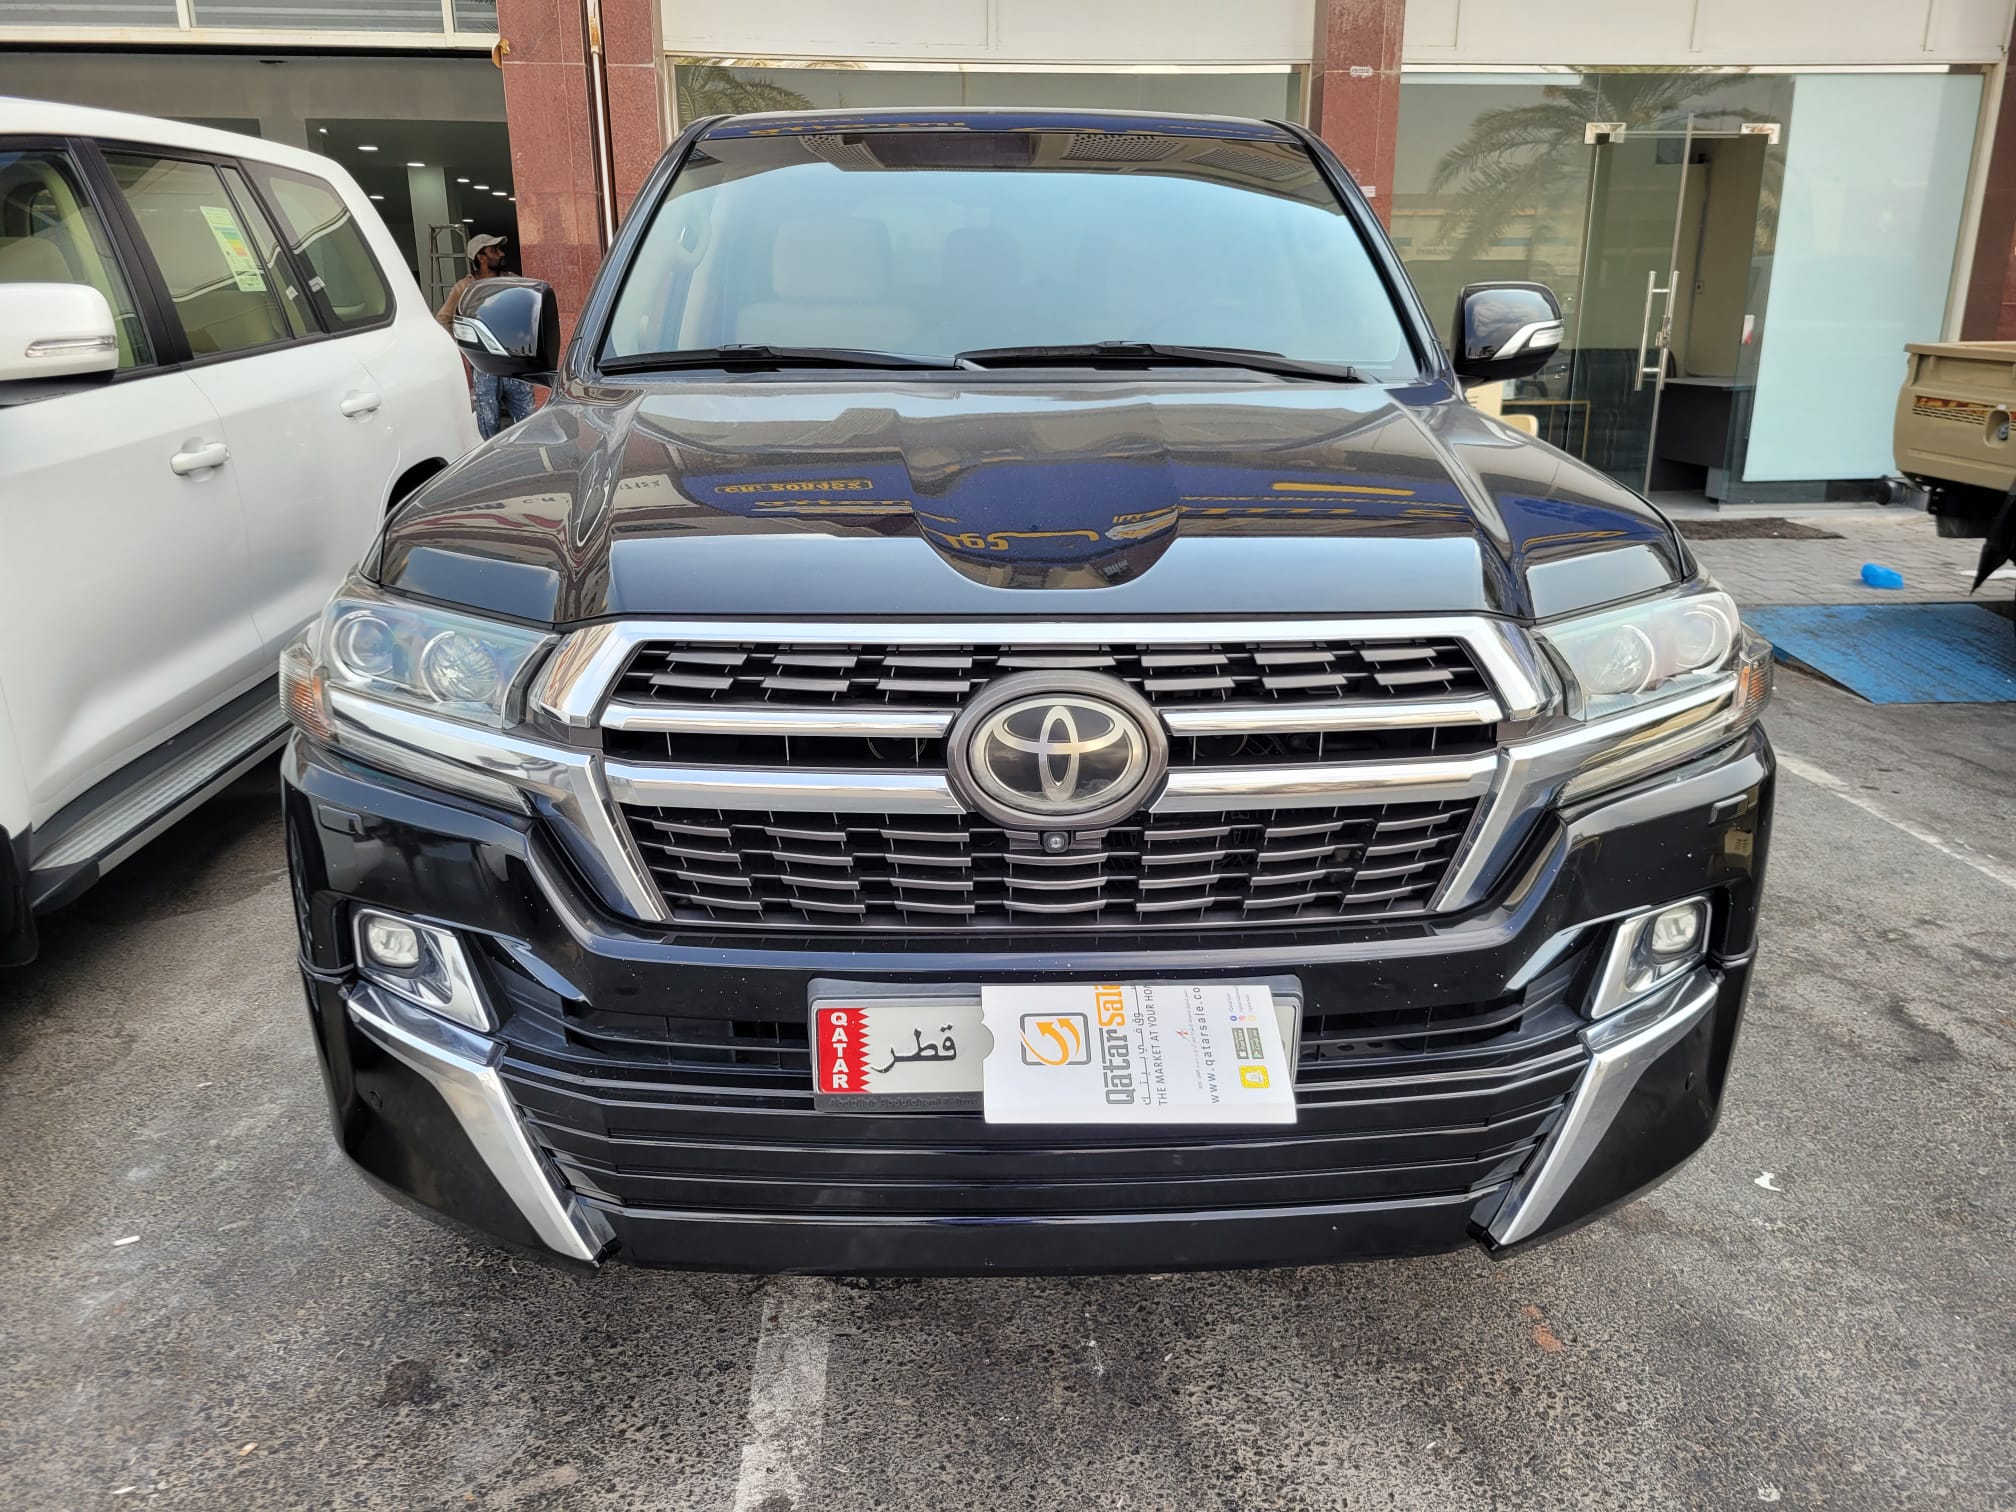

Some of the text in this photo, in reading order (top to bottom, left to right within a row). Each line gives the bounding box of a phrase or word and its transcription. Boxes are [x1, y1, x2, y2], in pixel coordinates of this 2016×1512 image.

[1146, 1004, 1158, 1028] YOUR
[830, 1011, 850, 1089] QATAR
[870, 1023, 957, 1074] قطر
[1149, 1031, 1160, 1042] AT
[1152, 1044, 1166, 1084] MARKET
[1157, 1087, 1169, 1106] THE
